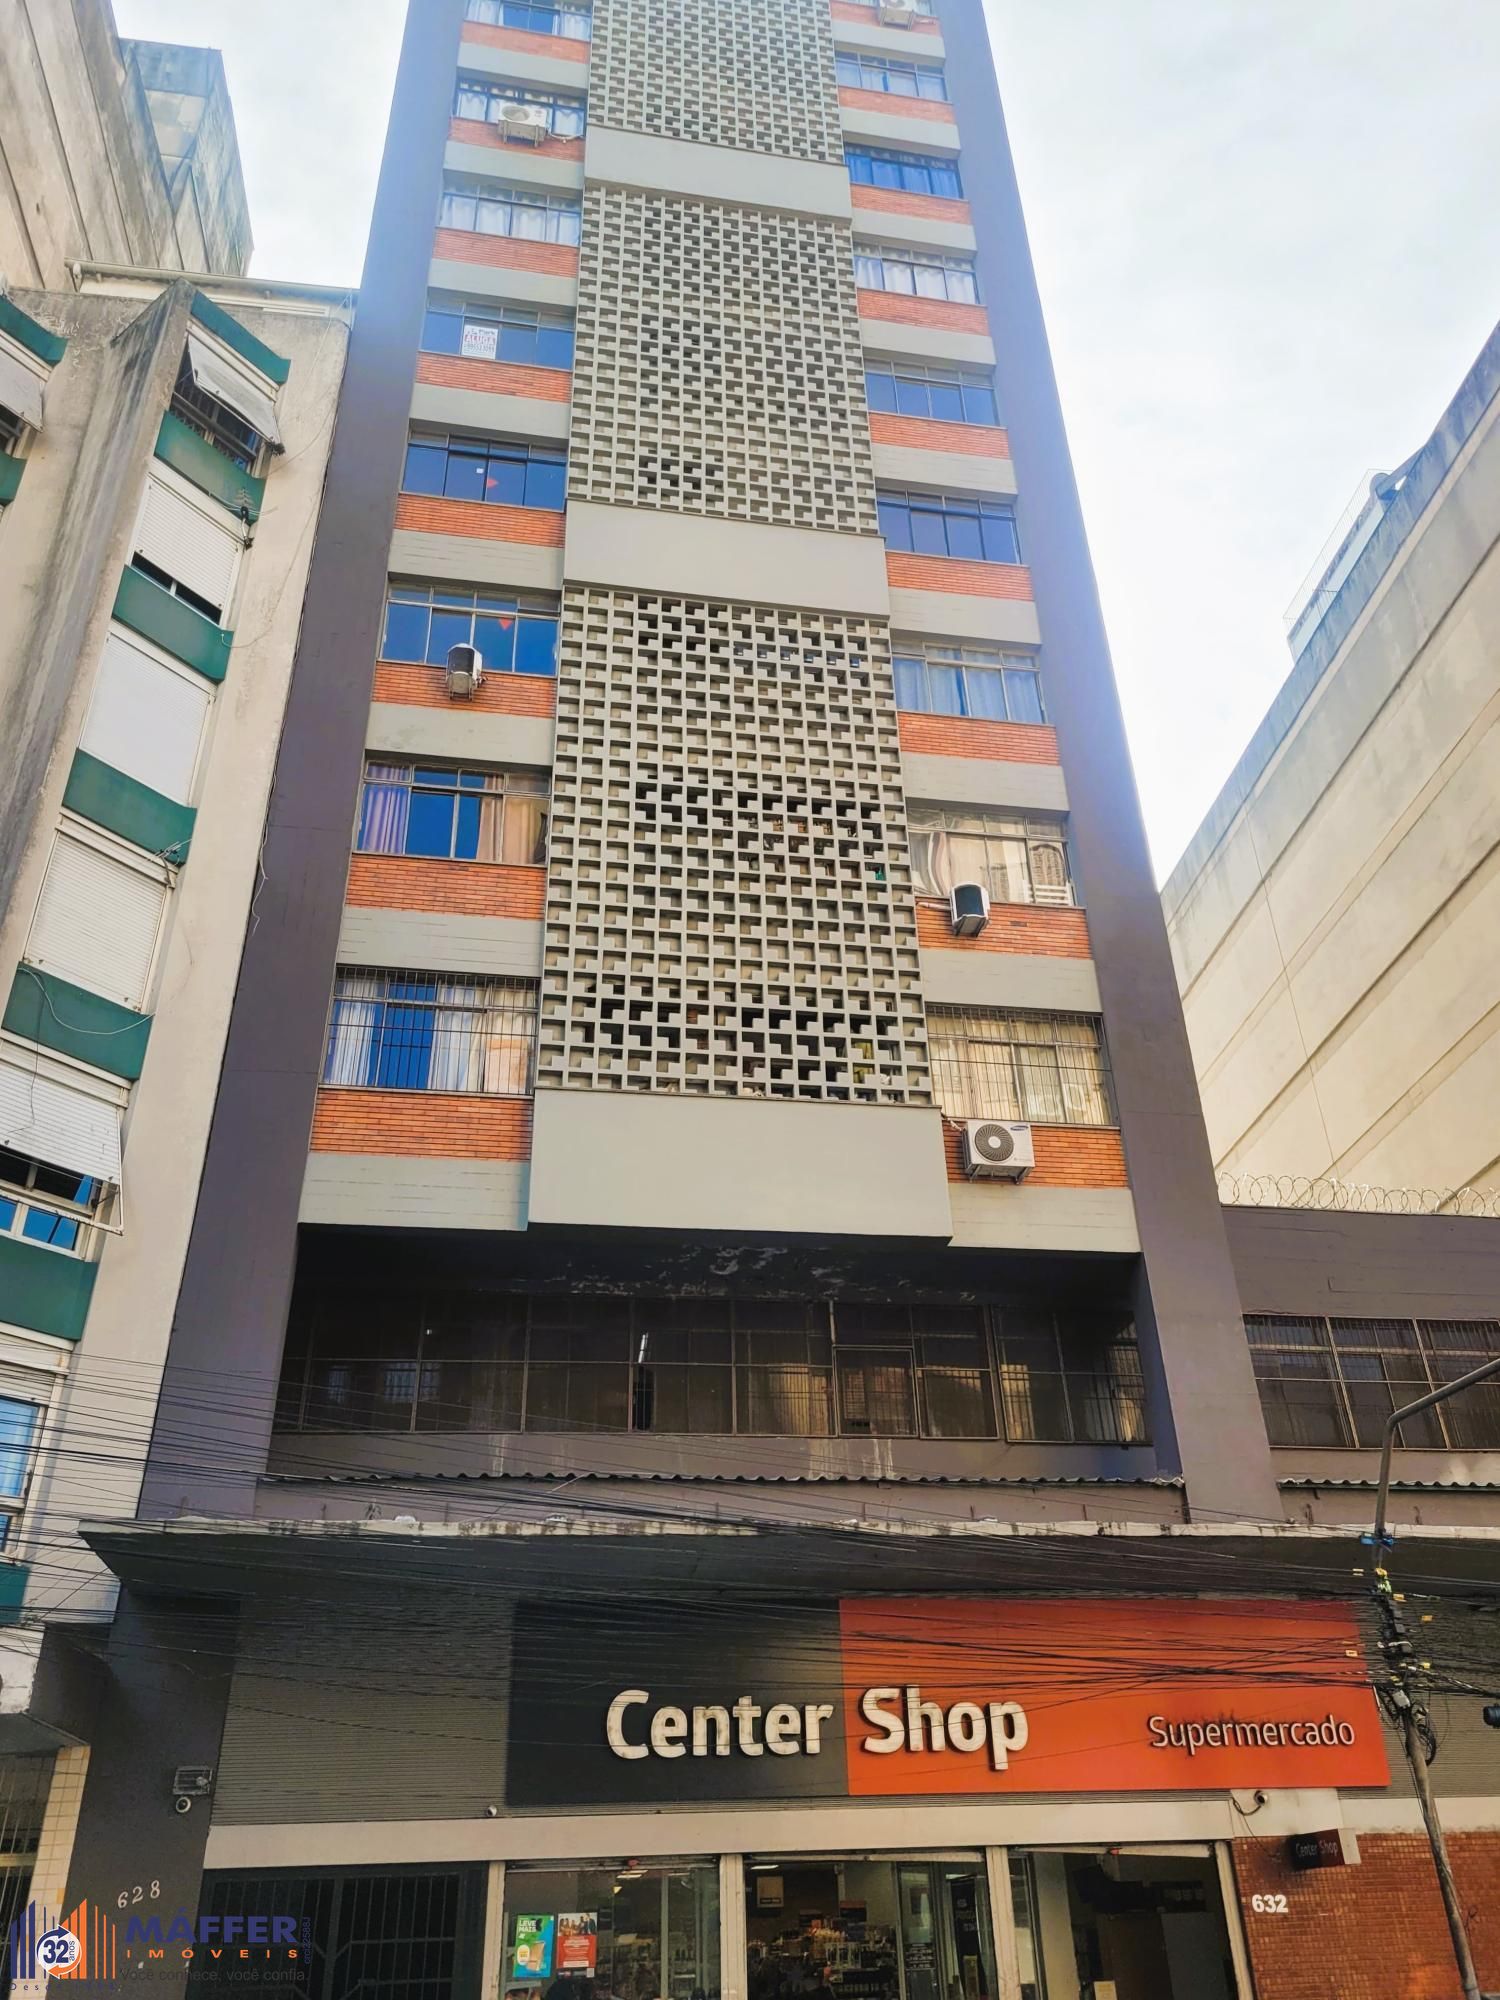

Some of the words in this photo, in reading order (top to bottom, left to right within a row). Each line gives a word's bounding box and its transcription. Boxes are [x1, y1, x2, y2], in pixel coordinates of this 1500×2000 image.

[606, 1689, 834, 1760] Center
[861, 1684, 1030, 1770] Shop
[1149, 1713, 1356, 1756] Supermercado
[117, 1879, 161, 1909] 628
[1251, 1894, 1289, 1913] 632
